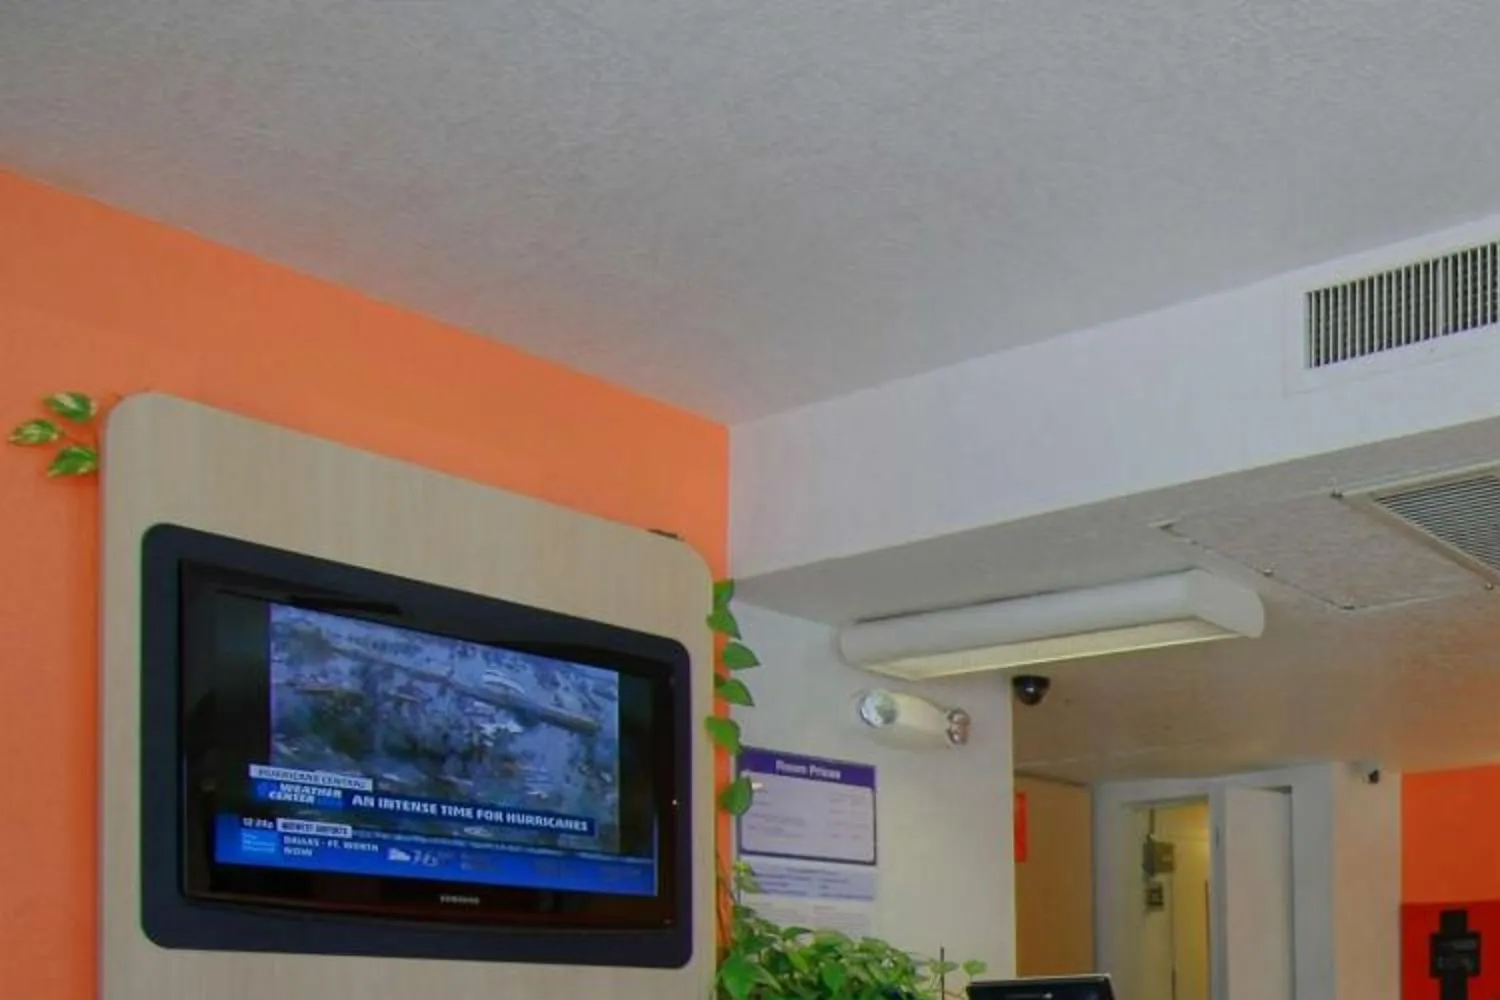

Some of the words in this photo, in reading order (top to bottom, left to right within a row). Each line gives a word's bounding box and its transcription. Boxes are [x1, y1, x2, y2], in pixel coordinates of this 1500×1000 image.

[351, 794, 375, 809] AN
[378, 797, 438, 815] INTENSE
[441, 804, 475, 820] TIME
[476, 808, 504, 823] FOR
[505, 813, 588, 832] HURRICANES
